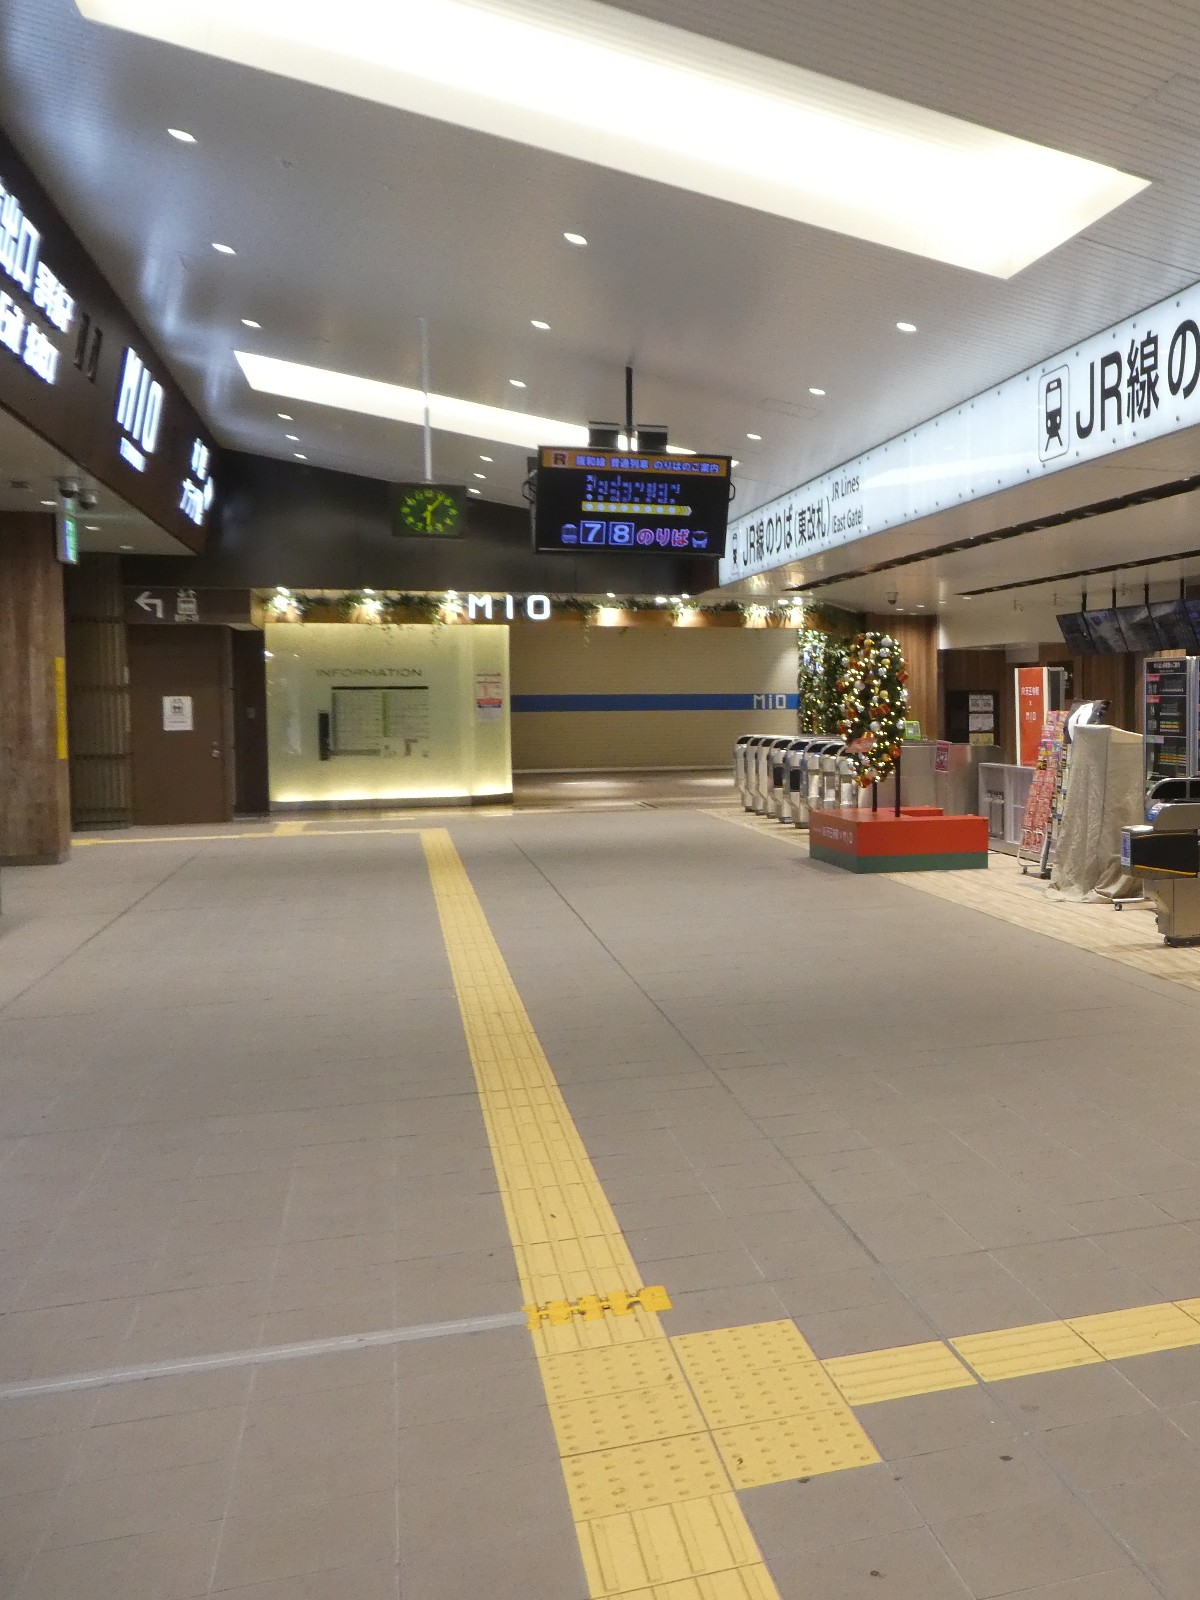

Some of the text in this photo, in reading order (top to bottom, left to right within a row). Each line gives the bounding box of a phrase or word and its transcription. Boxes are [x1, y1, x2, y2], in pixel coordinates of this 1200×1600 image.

[831, 475, 860, 501] JR Lines
[468, 593, 551, 620] MIO
[315, 668, 423, 678] INFORMATION
